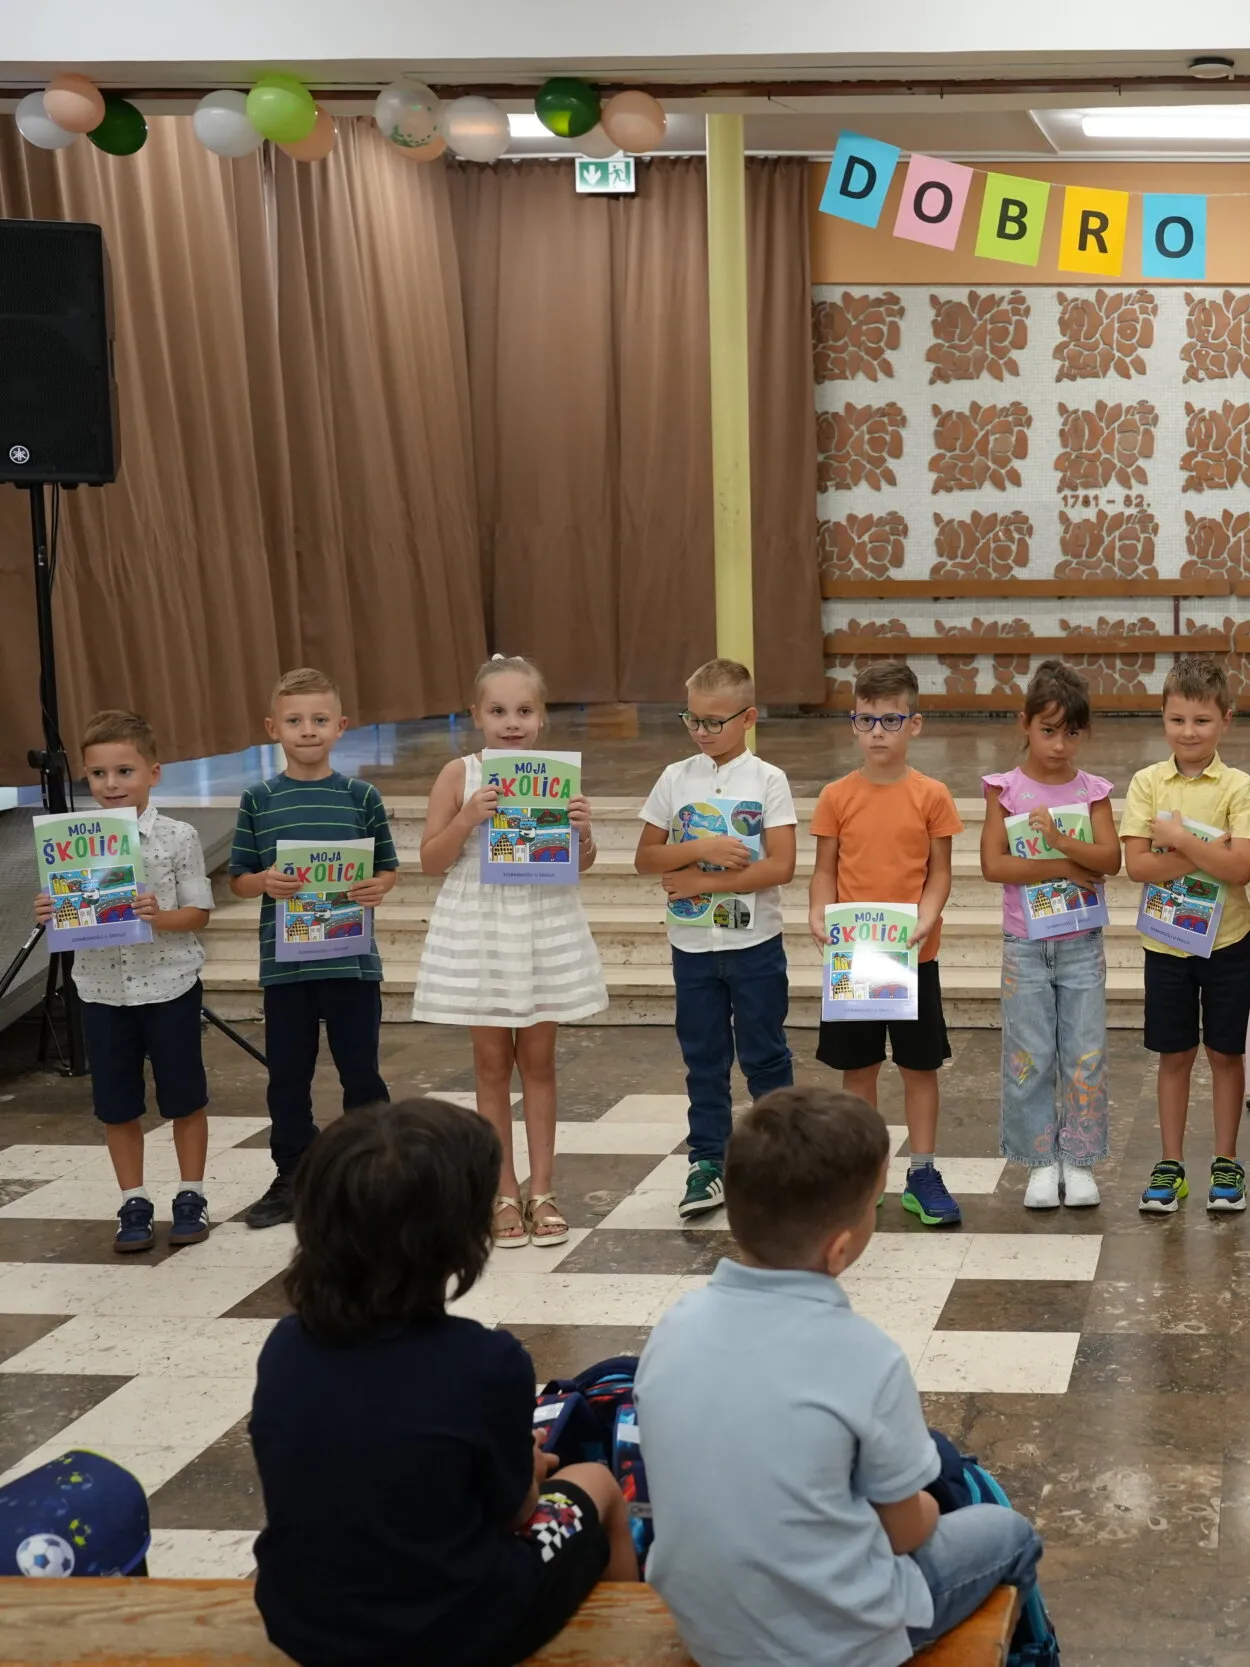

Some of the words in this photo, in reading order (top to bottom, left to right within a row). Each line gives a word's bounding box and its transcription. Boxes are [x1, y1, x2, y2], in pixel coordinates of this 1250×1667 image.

[839, 154, 1194, 259] DOBRO
[515, 762, 546, 775] MOJA
[68, 822, 102, 837] MOJA
[310, 851, 342, 863] MOJA
[855, 912, 885, 922] MOJA
